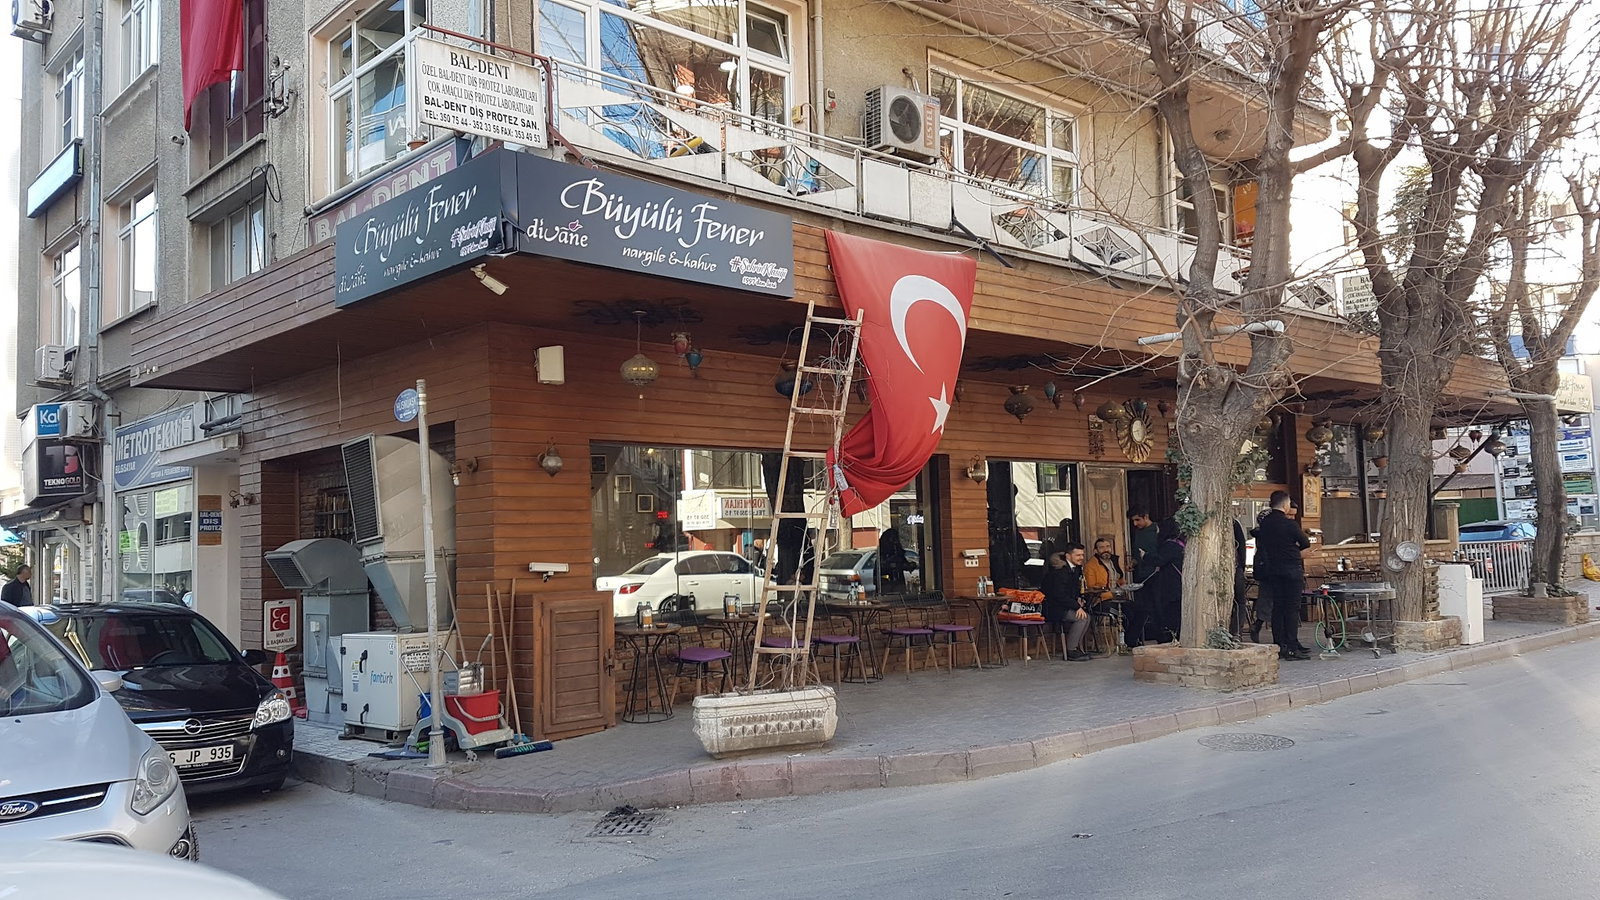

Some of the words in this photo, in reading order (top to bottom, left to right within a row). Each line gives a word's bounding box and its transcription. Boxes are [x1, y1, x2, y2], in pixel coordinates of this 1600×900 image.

[421, 61, 437, 77] ÖZEL
[439, 67, 466, 85] BAL-DENT
[479, 78, 500, 93] PROTEZ
[450, 51, 510, 79] BAL-DENT
[427, 80, 440, 94] ÇOK
[475, 92, 497, 106] PROTEZ
[424, 96, 467, 114] BAL-DENT
[470, 105, 484, 121] DİŞ
[486, 110, 519, 126] PROTEZ
[520, 118, 540, 131] SAN.
[424, 109, 439, 120] TEL:
[440, 112, 451, 123] 350
[452, 115, 459, 125] 75
[461, 117, 468, 126] 44
[473, 120, 483, 131] 352
[484, 123, 492, 132] 33
[501, 127, 514, 138] FAX:
[514, 130, 525, 140] 353
[526, 132, 533, 142] 49
[534, 134, 541, 144] 53
[560, 178, 684, 240] Büyülü
[677, 201, 765, 249] Fener
[622, 246, 666, 267] nargile
[186, 750, 200, 763] JP
[210, 746, 231, 760] 935
[1, 802, 28, 816] Ford
